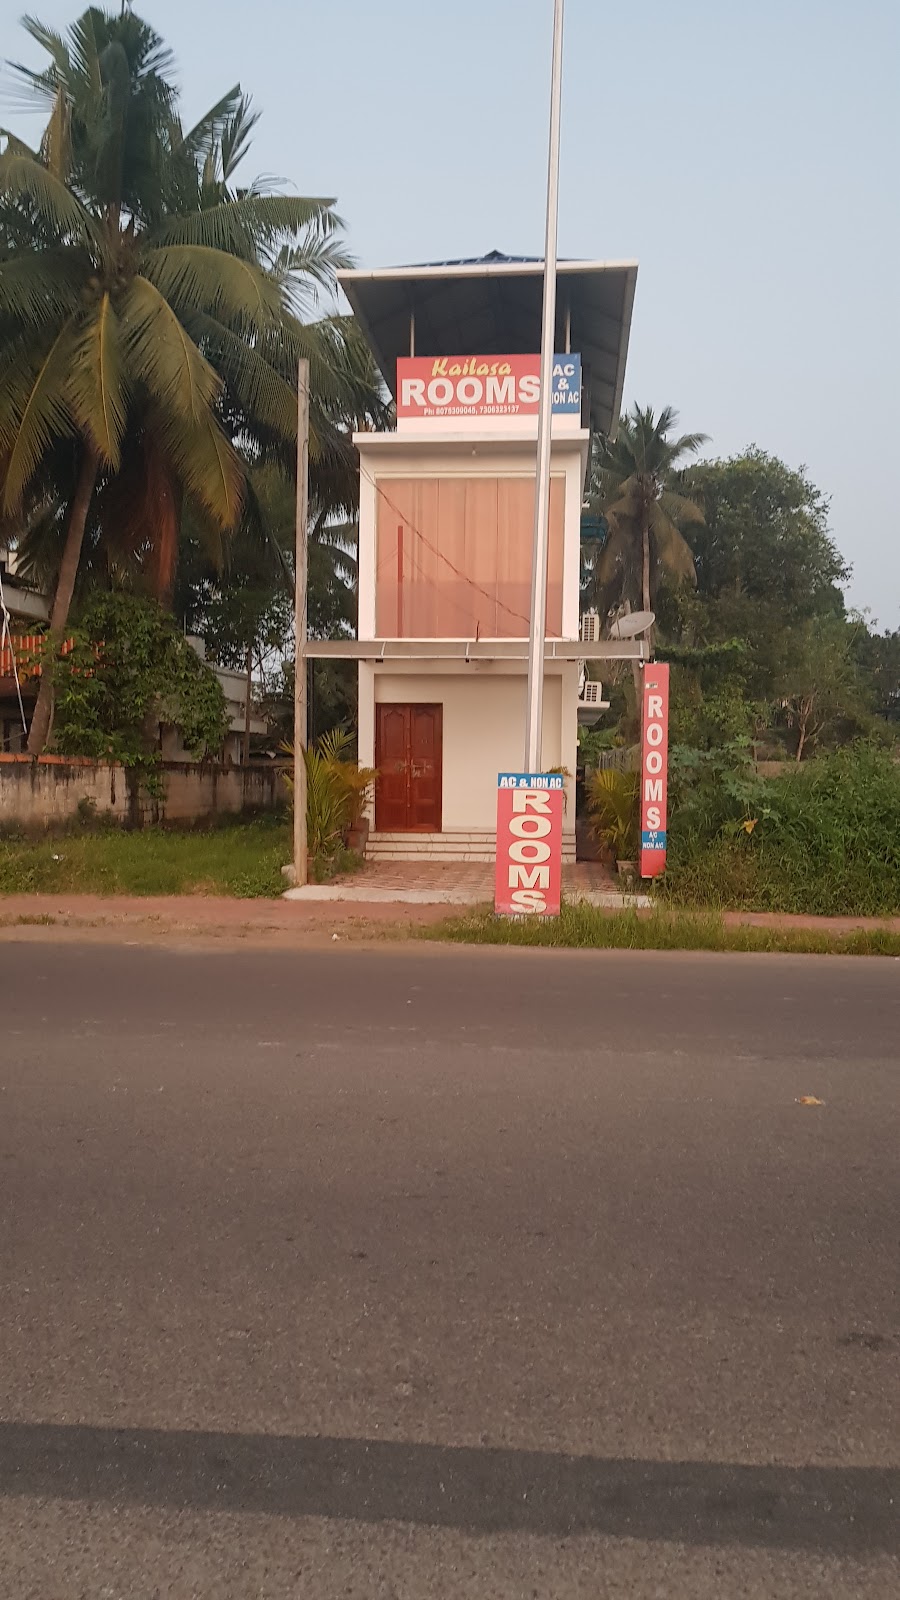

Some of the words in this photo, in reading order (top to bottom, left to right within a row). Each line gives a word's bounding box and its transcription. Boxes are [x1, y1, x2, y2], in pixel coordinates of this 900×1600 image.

[431, 357, 512, 377] Kailasa
[552, 363, 575, 377] AC
[401, 374, 540, 406] ROOMS
[557, 377, 569, 391] &
[567, 391, 579, 404] AC
[644, 694, 664, 830] ROOMS
[500, 776, 517, 788] AC
[519, 777, 529, 788] &
[530, 776, 549, 788] NON
[549, 777, 562, 788] AC
[508, 789, 553, 914] ROOMS
